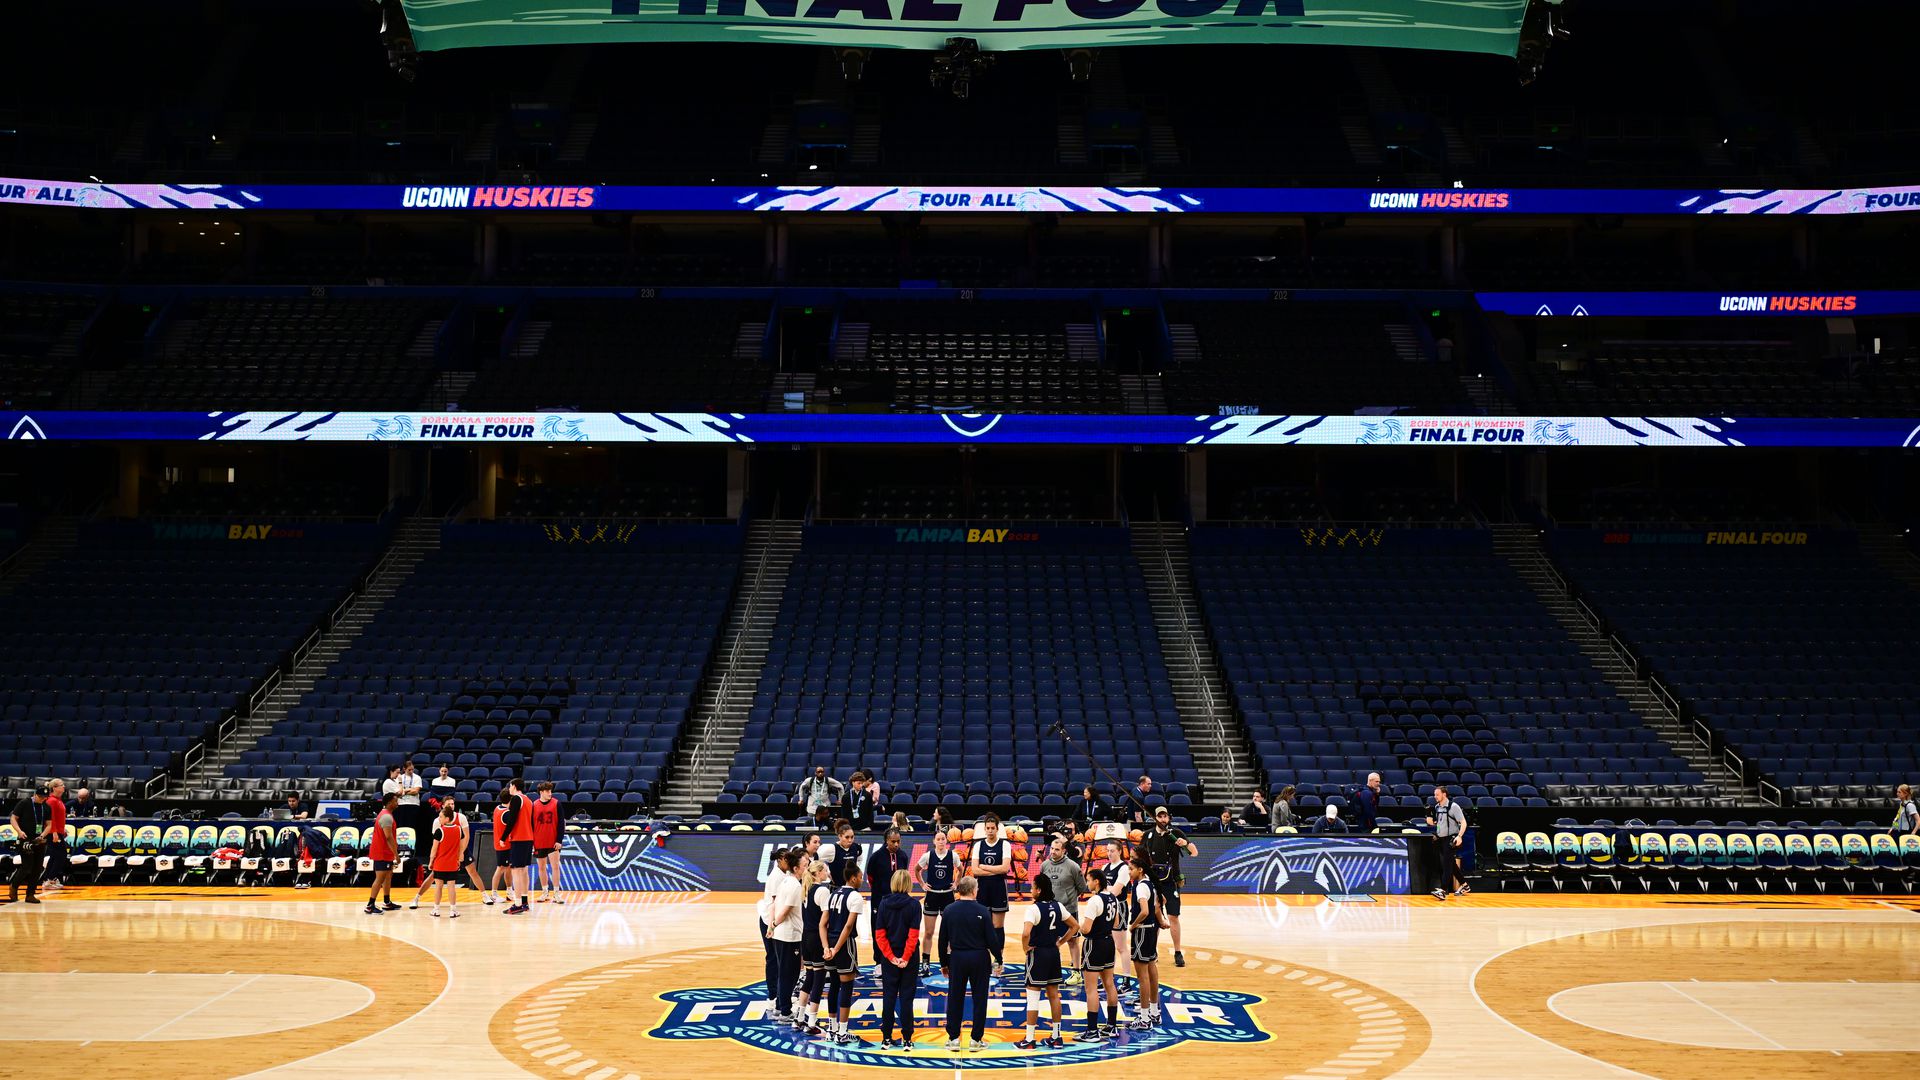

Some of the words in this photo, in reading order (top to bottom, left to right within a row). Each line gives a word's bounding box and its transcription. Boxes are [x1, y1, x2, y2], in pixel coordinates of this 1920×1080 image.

[36, 187, 75, 201] ALL
[402, 187, 469, 207] UCONN
[473, 187, 594, 207] HUSKIES
[919, 194, 970, 206] FOUR
[980, 194, 1015, 206] ALL
[1370, 193, 1418, 208] UCONN
[1421, 193, 1508, 208] HUSKIES
[1865, 192, 1920, 207] FOUR
[640, 288, 654, 298] 230
[960, 290, 973, 300] 201
[1273, 290, 1287, 300] 202
[1719, 296, 1767, 311] UCONN
[1770, 296, 1856, 311] HUSKIES
[451, 416, 481, 424] NCAA
[484, 416, 535, 424] WOMEN'S
[420, 425, 477, 438] FINAL
[482, 425, 535, 438] FOUR
[1409, 429, 1467, 442] FINAL
[1472, 429, 1525, 442] FOUR
[152, 523, 224, 540] TAMPA
[227, 524, 272, 540] BAY
[895, 528, 964, 543] TAMPA
[966, 528, 1009, 543] BAY
[1706, 532, 1758, 544] FINAL
[1760, 532, 1808, 544] FOUR
[537, 811, 553, 824] 43
[829, 893, 845, 914] 44
[1049, 911, 1057, 930] 2
